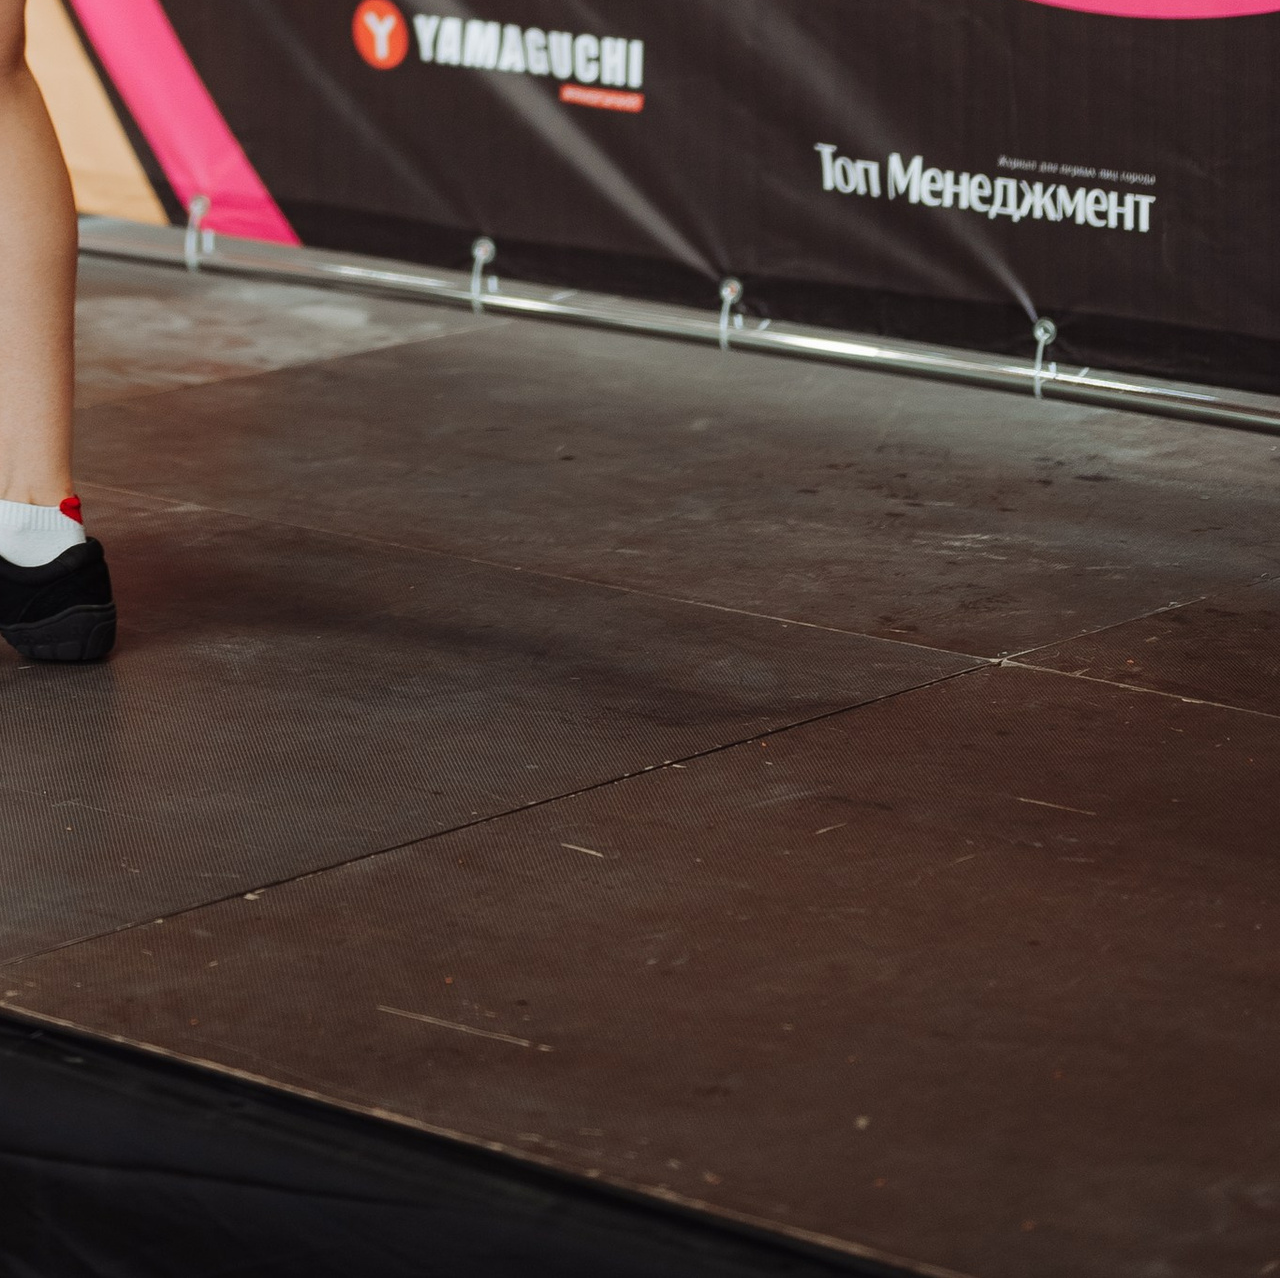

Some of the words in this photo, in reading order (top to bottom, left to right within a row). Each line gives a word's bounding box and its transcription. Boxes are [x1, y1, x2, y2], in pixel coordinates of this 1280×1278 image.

[413, 13, 644, 89] YAMAGUCHI
[813, 142, 881, 198] Топ
[887, 151, 1157, 233] Менеджмент
